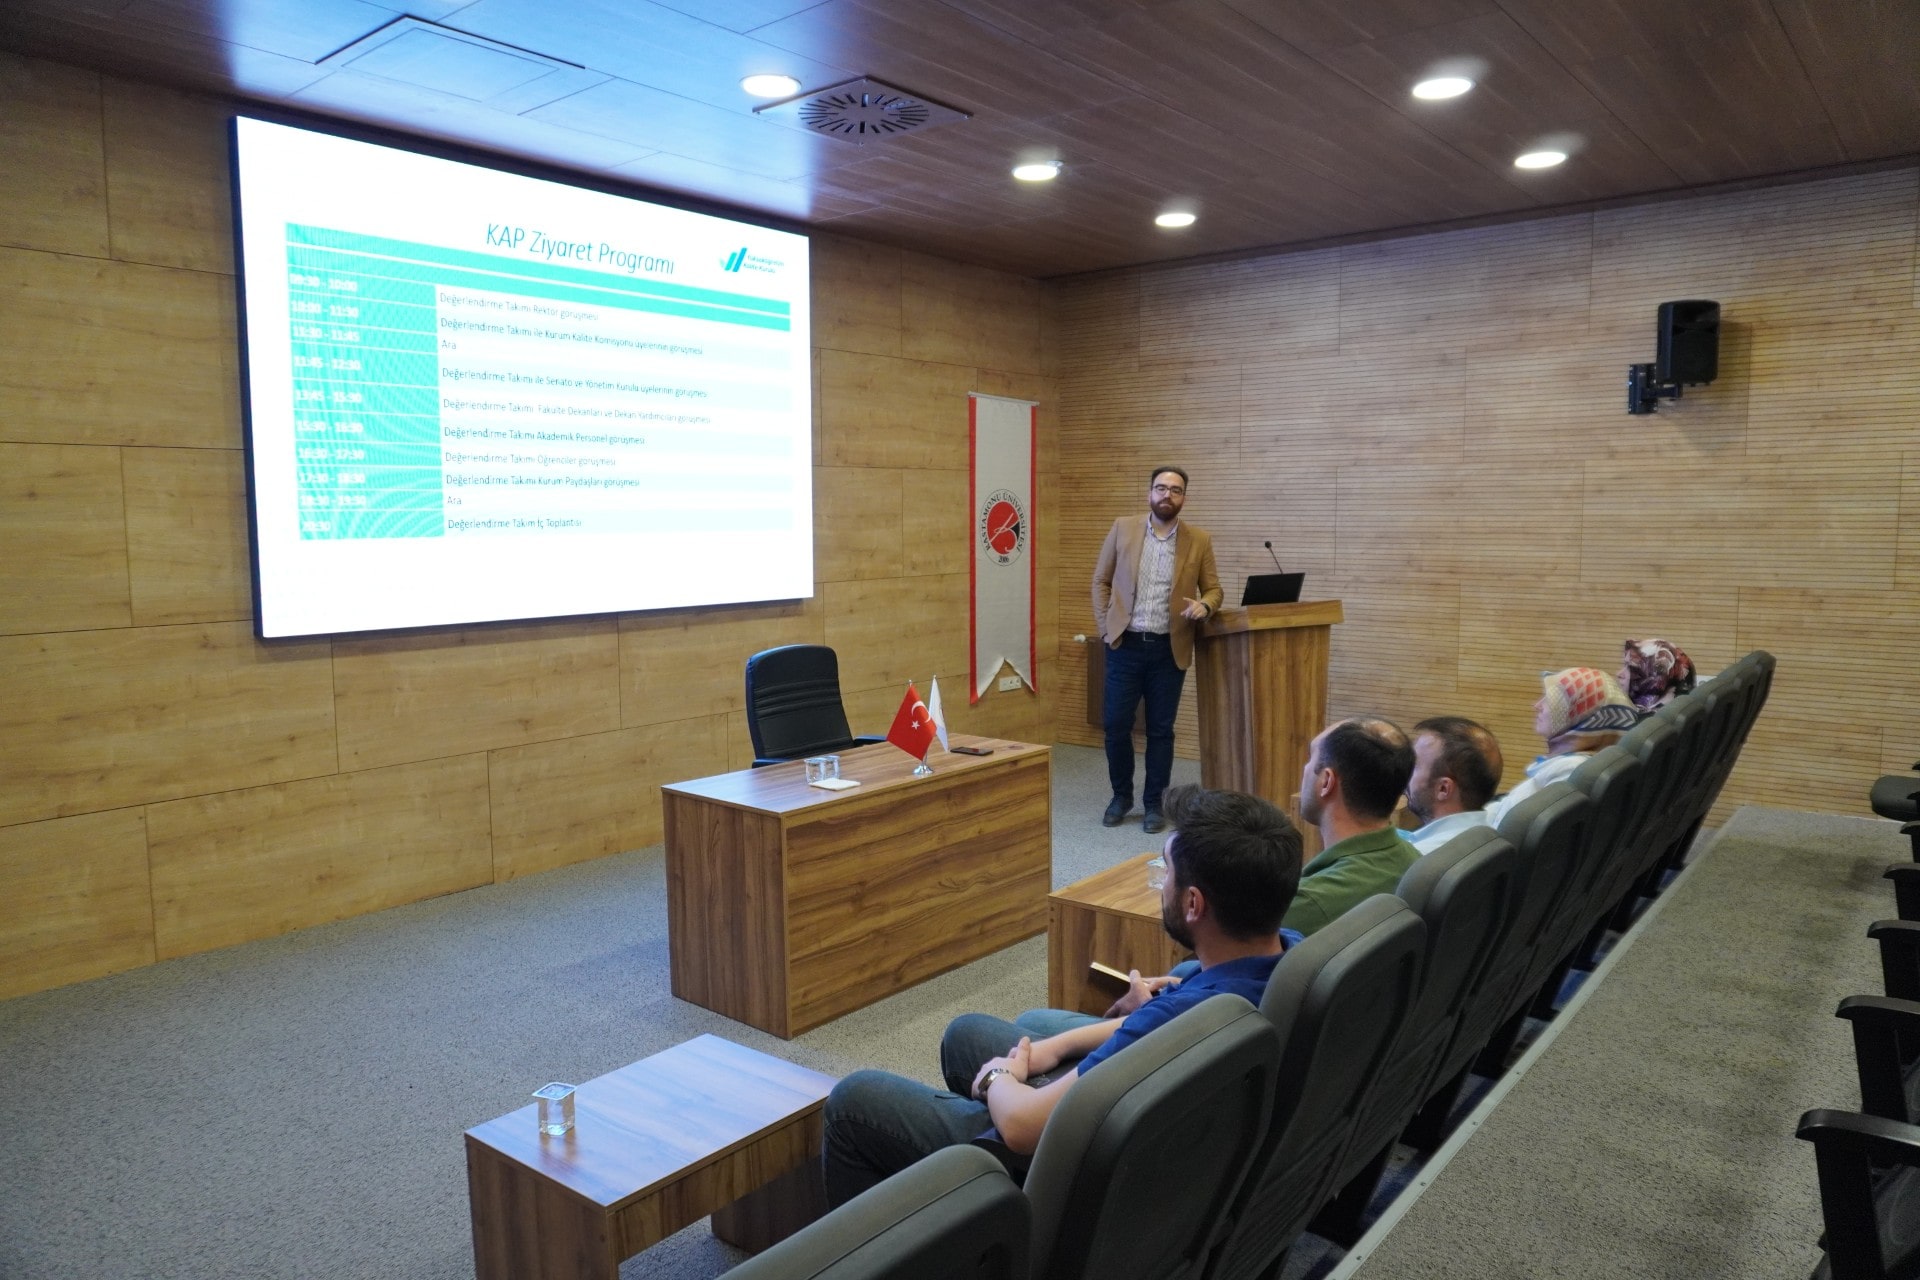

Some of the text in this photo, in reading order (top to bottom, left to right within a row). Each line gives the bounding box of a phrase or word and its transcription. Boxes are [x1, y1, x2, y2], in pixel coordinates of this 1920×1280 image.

[486, 223, 675, 274] KAP Ziyaret Programı
[441, 339, 457, 350] Ara
[536, 431, 574, 442] Akademik
[576, 432, 608, 443] Personel
[447, 495, 462, 505] Ara
[981, 493, 1001, 551] KASTAMONU
